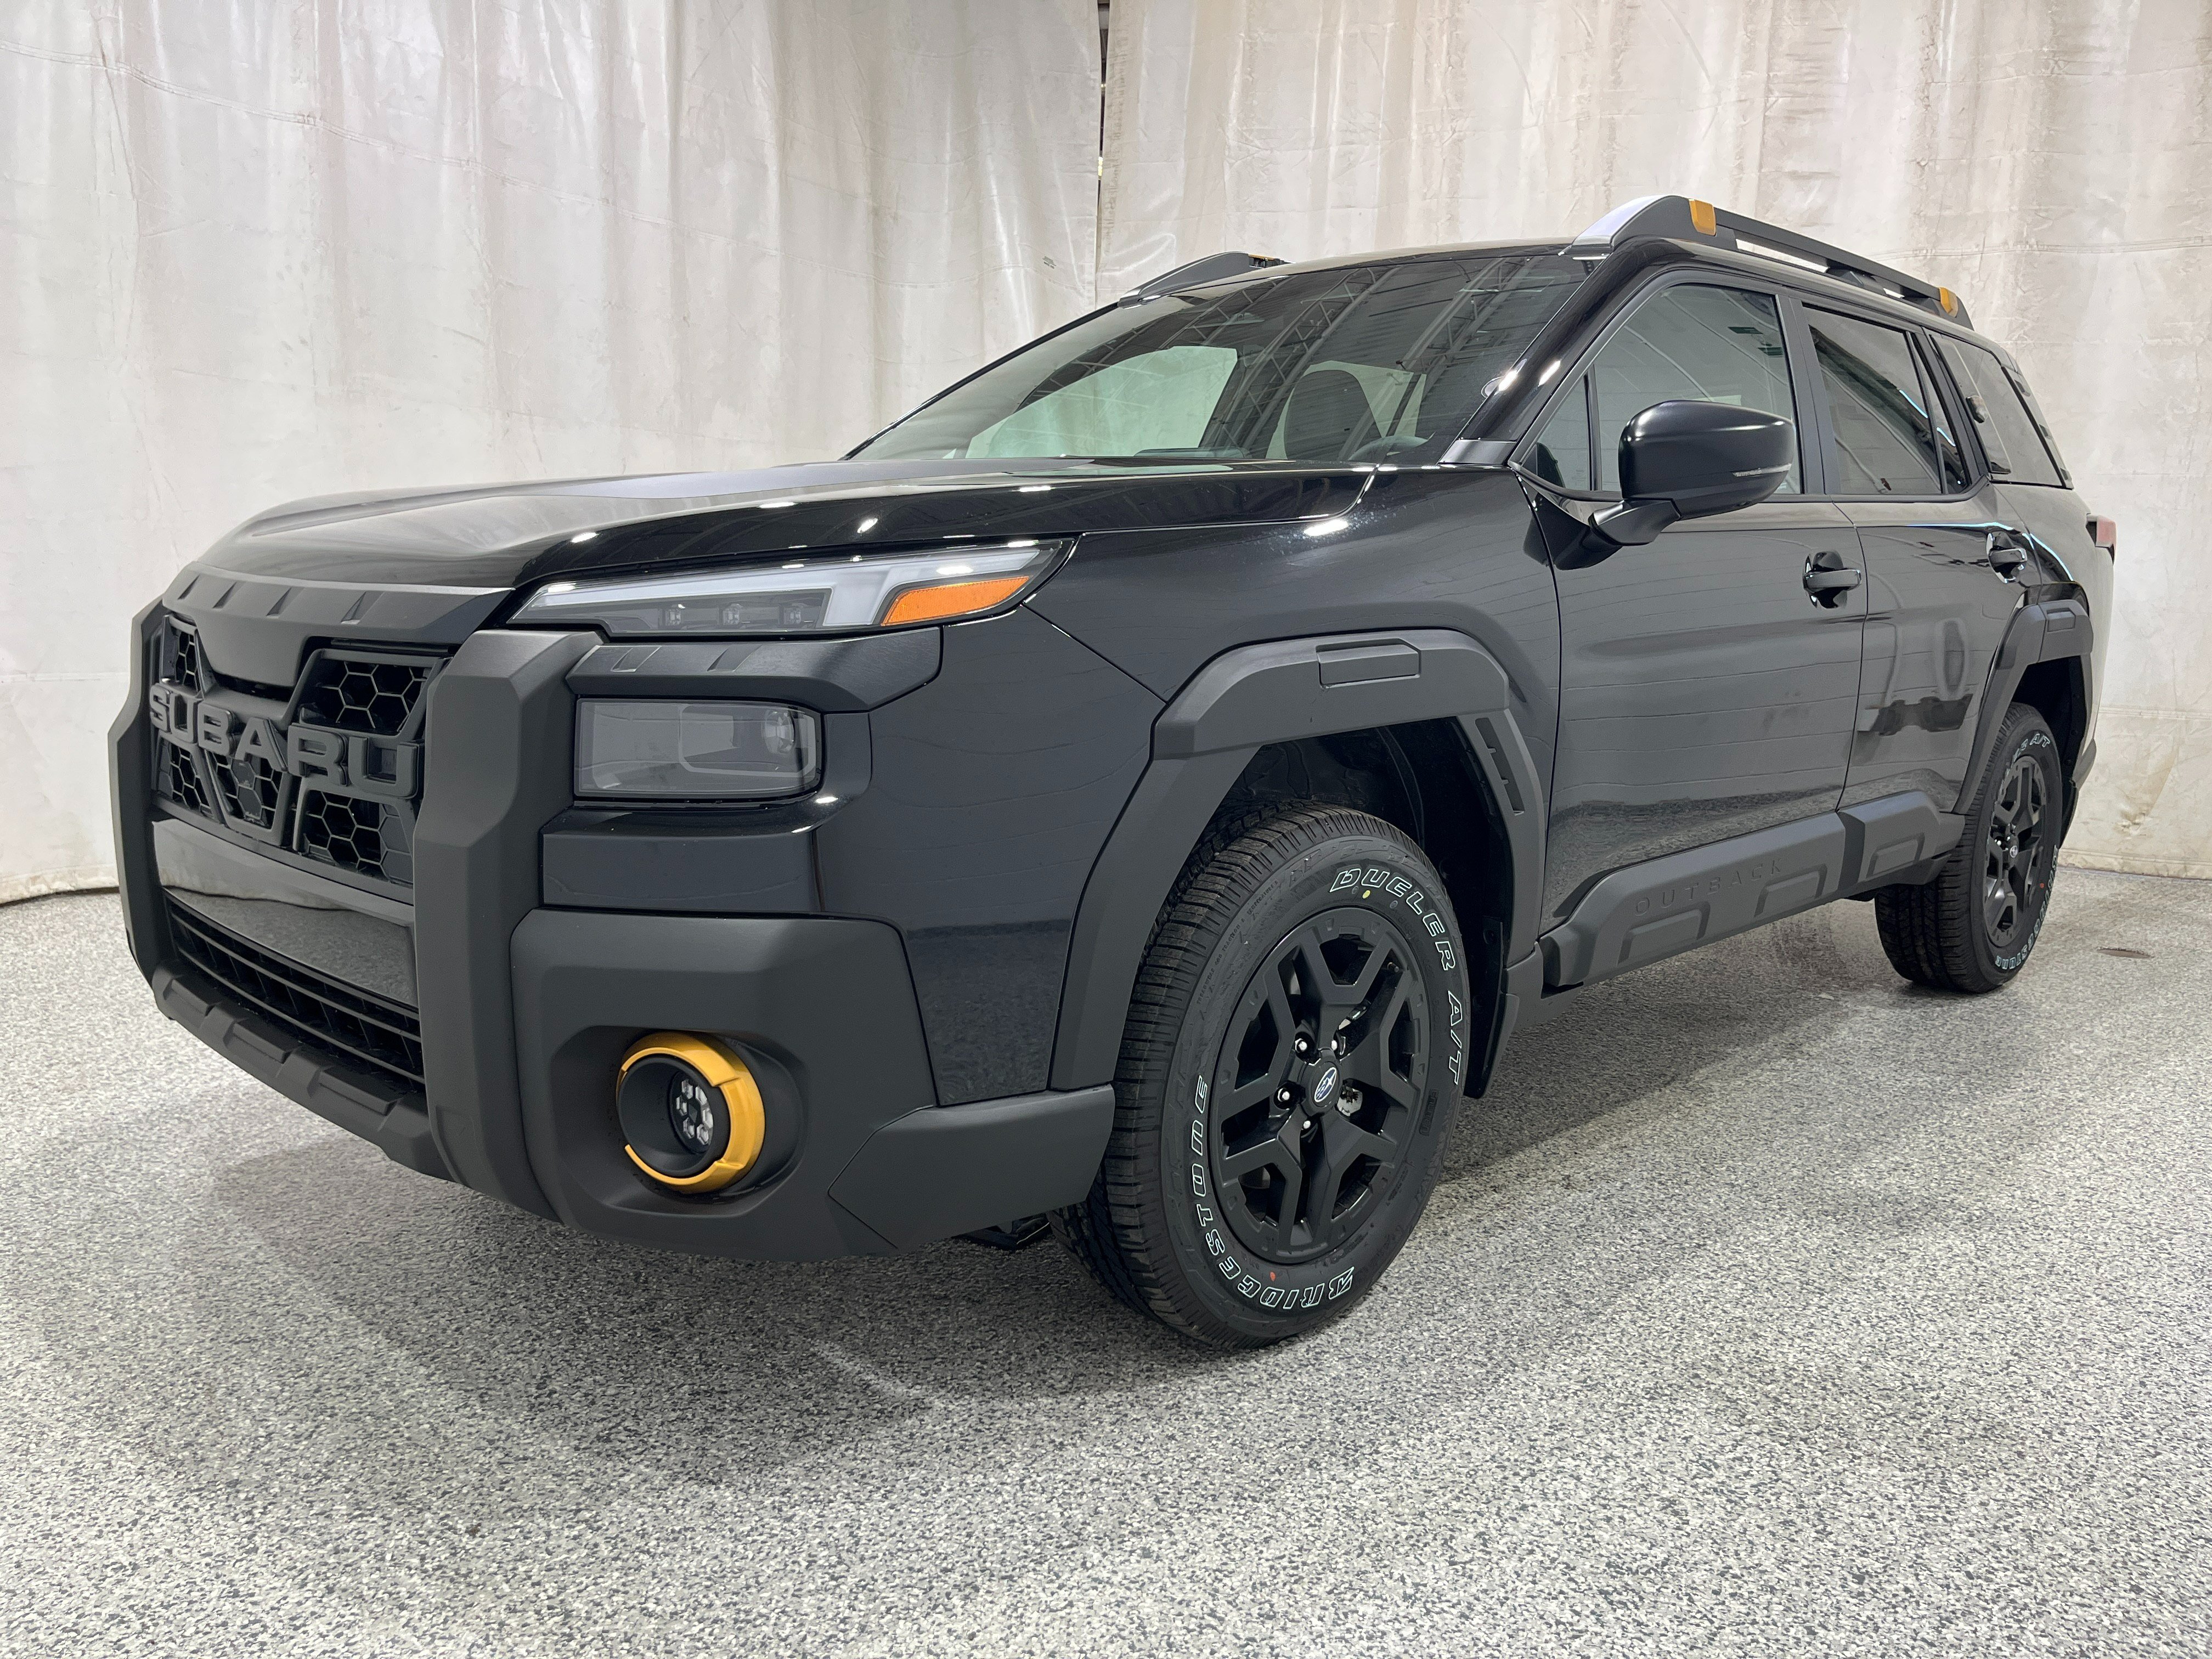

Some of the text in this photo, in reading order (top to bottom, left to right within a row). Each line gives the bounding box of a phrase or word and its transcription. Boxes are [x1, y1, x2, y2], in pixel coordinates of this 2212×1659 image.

[149, 683, 422, 799] SUBARU
[1635, 860, 1781, 917] OUTBACK
[1330, 868, 1467, 1085] DUELER A/T
[1191, 1075, 1355, 1309] BRIDGESTONE
